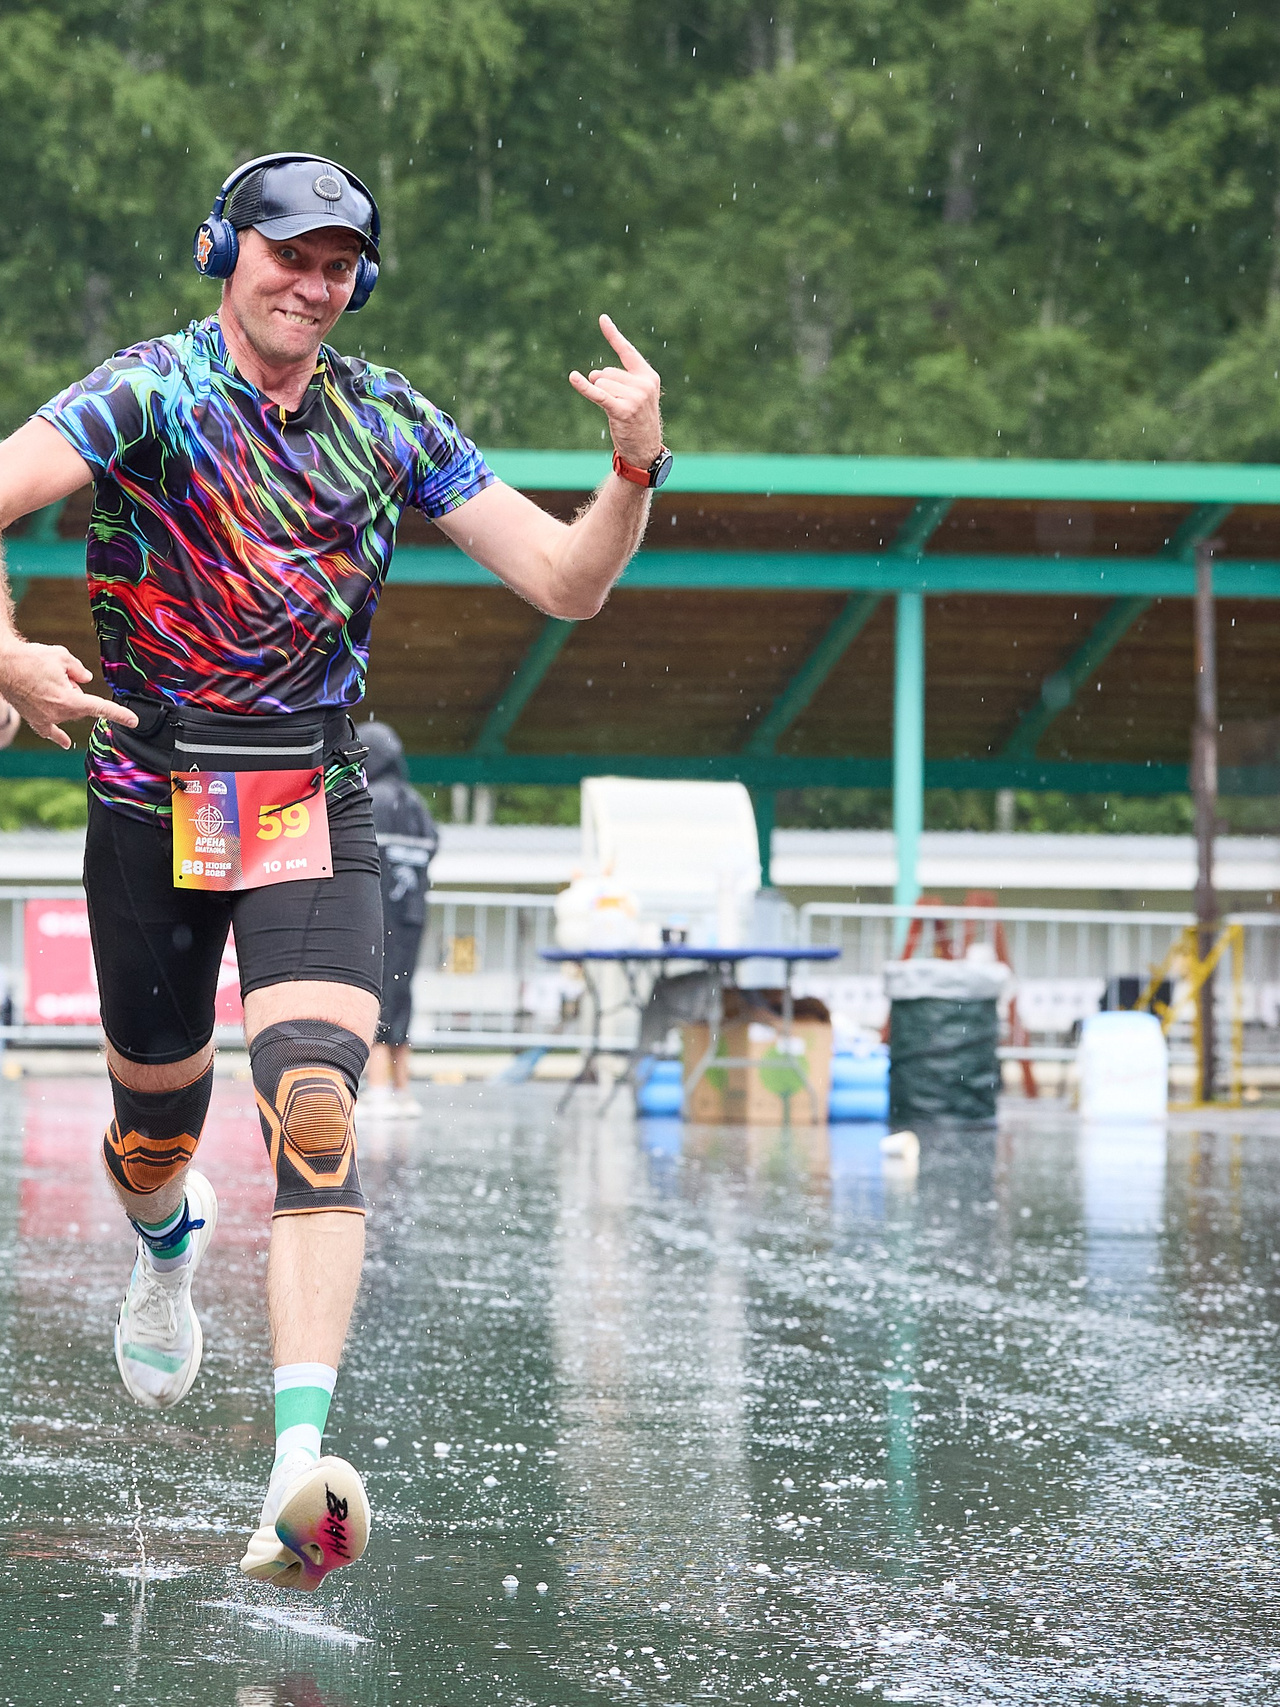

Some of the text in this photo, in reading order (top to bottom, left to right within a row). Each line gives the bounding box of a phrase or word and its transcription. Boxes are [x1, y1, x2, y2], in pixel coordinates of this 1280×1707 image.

[256, 803, 310, 840] 59
[195, 836, 226, 847] АРЕНА
[181, 859, 204, 875] 28
[263, 860, 282, 873] 10
